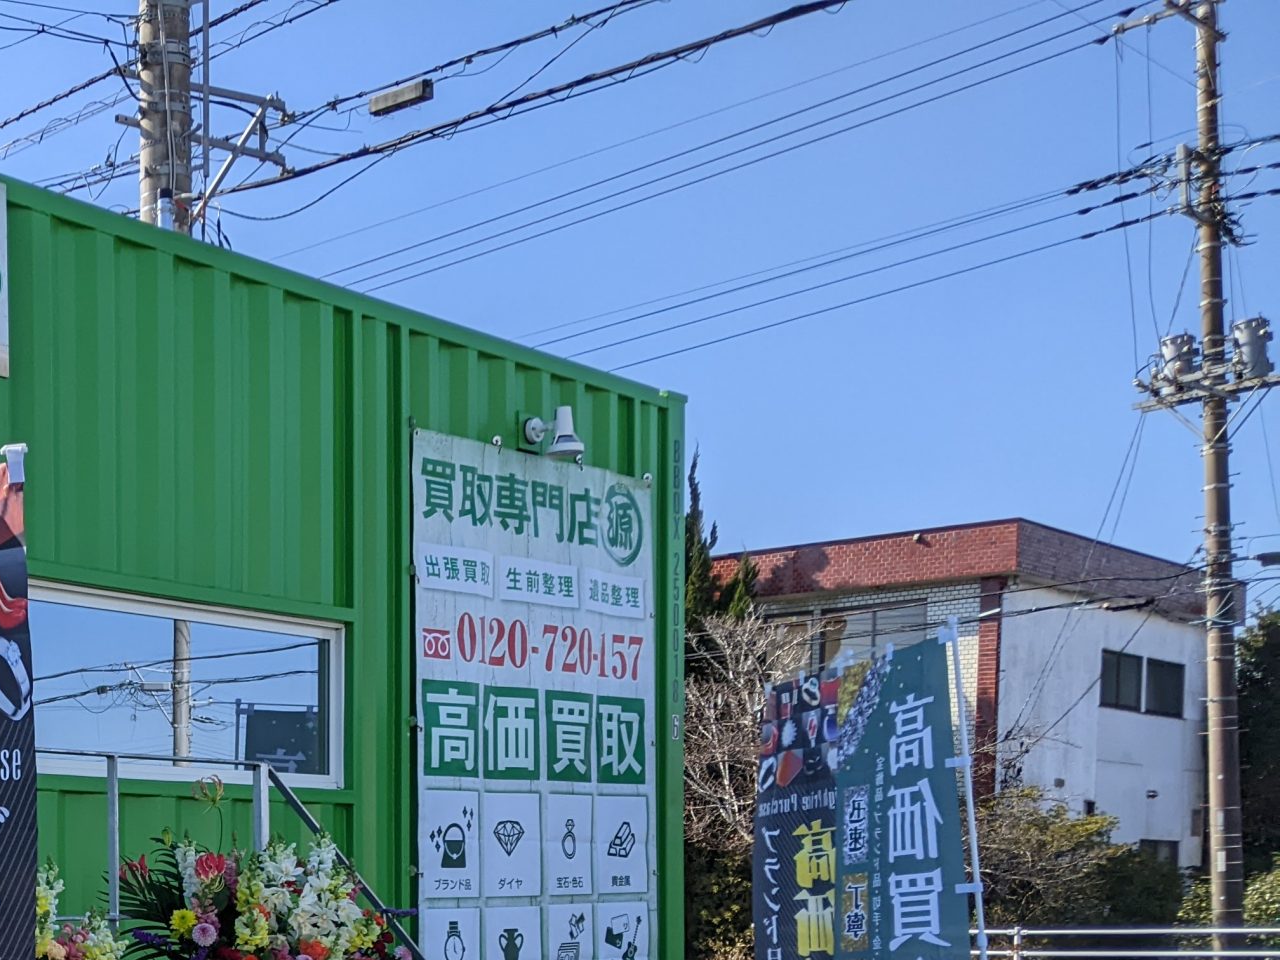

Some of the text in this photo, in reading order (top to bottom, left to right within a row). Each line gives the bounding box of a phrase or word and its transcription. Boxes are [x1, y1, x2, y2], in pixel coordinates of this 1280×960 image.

[420, 456, 601, 549] 買取専門店
[423, 553, 640, 609] 出張買取 生前整理 遺品整理
[456, 611, 644, 682] 0120-720-157
[424, 687, 643, 777] 高価買取
[433, 877, 473, 891] ブランド品
[497, 877, 523, 890] ダイヤ
[610, 875, 632, 887] 貴金属
